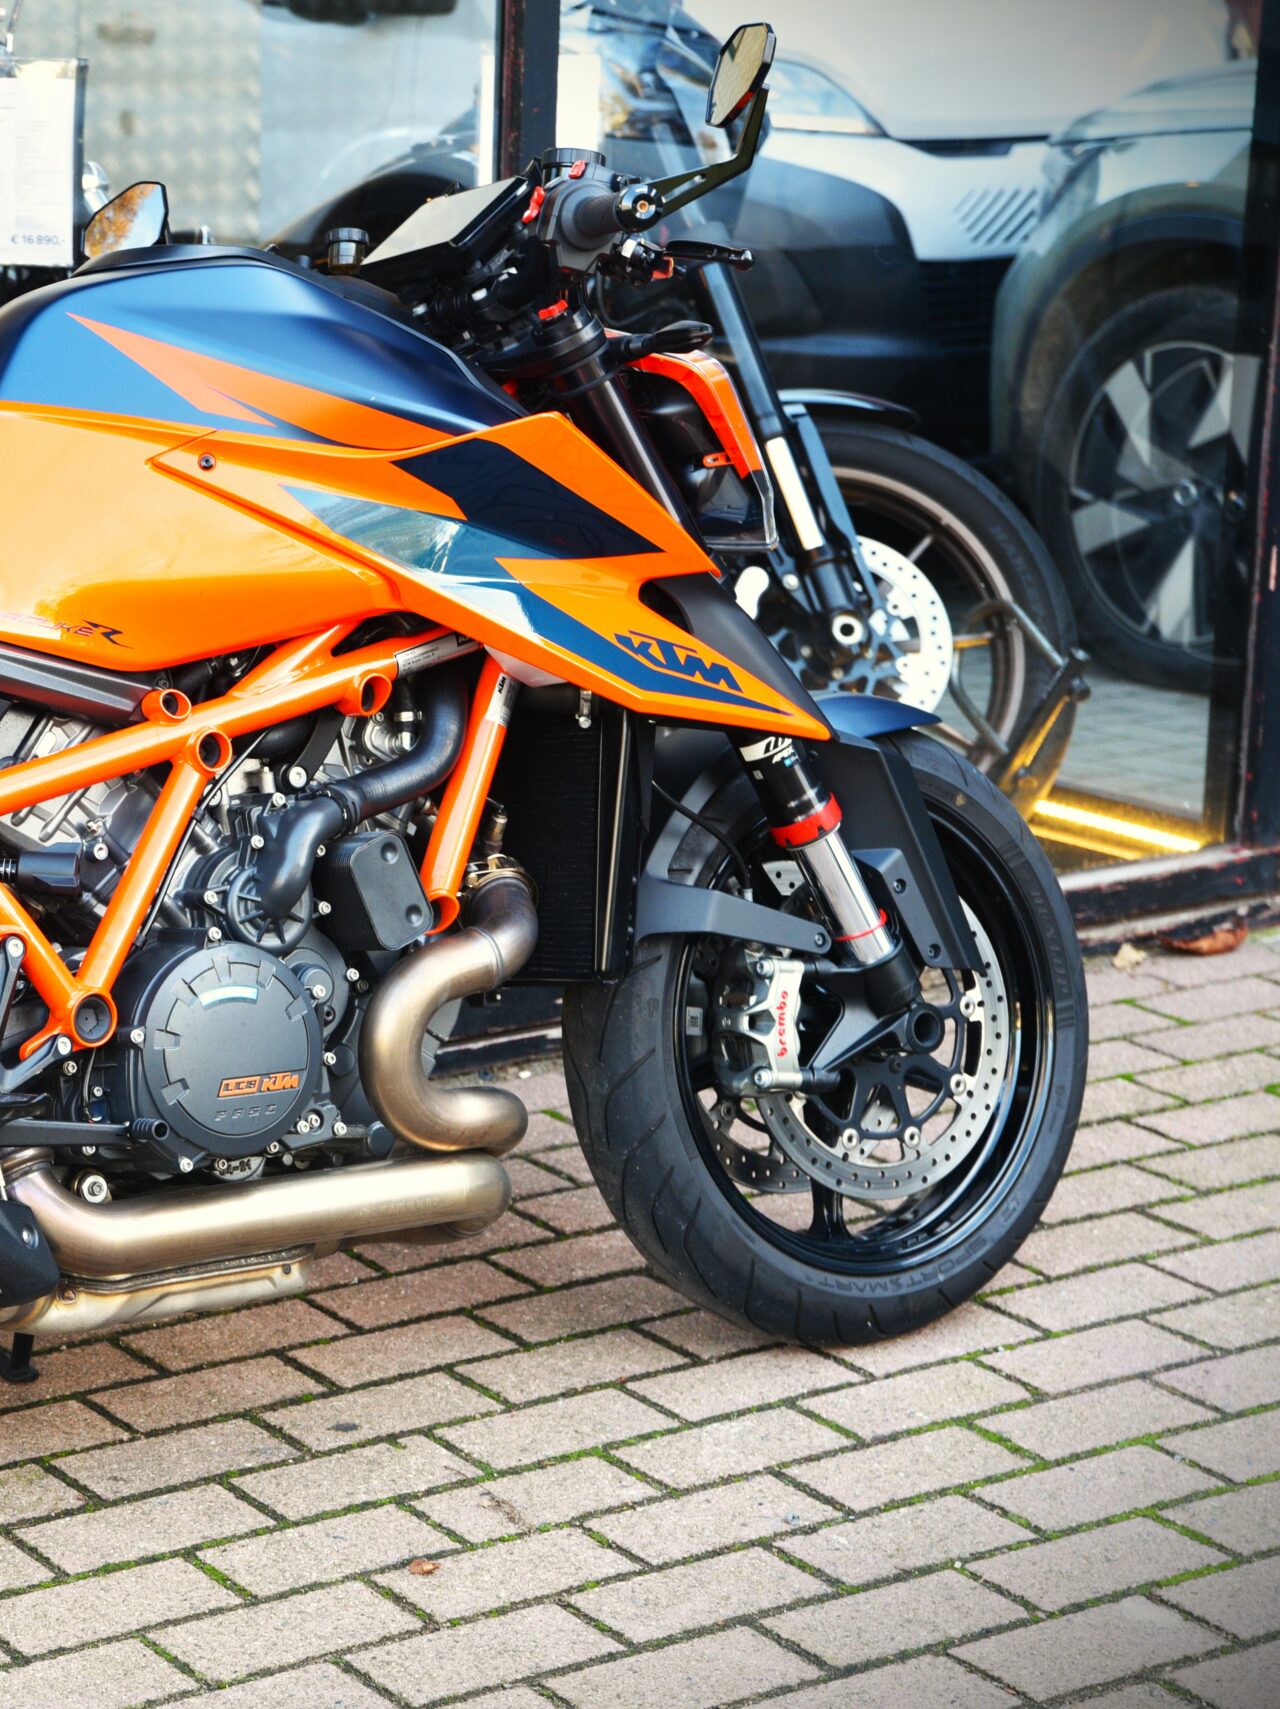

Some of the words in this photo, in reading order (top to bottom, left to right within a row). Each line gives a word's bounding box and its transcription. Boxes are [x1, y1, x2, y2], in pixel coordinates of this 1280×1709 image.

[614, 630, 744, 693] KTM
[776, 990, 789, 1057] brembo
[261, 1072, 300, 1092] KTM
